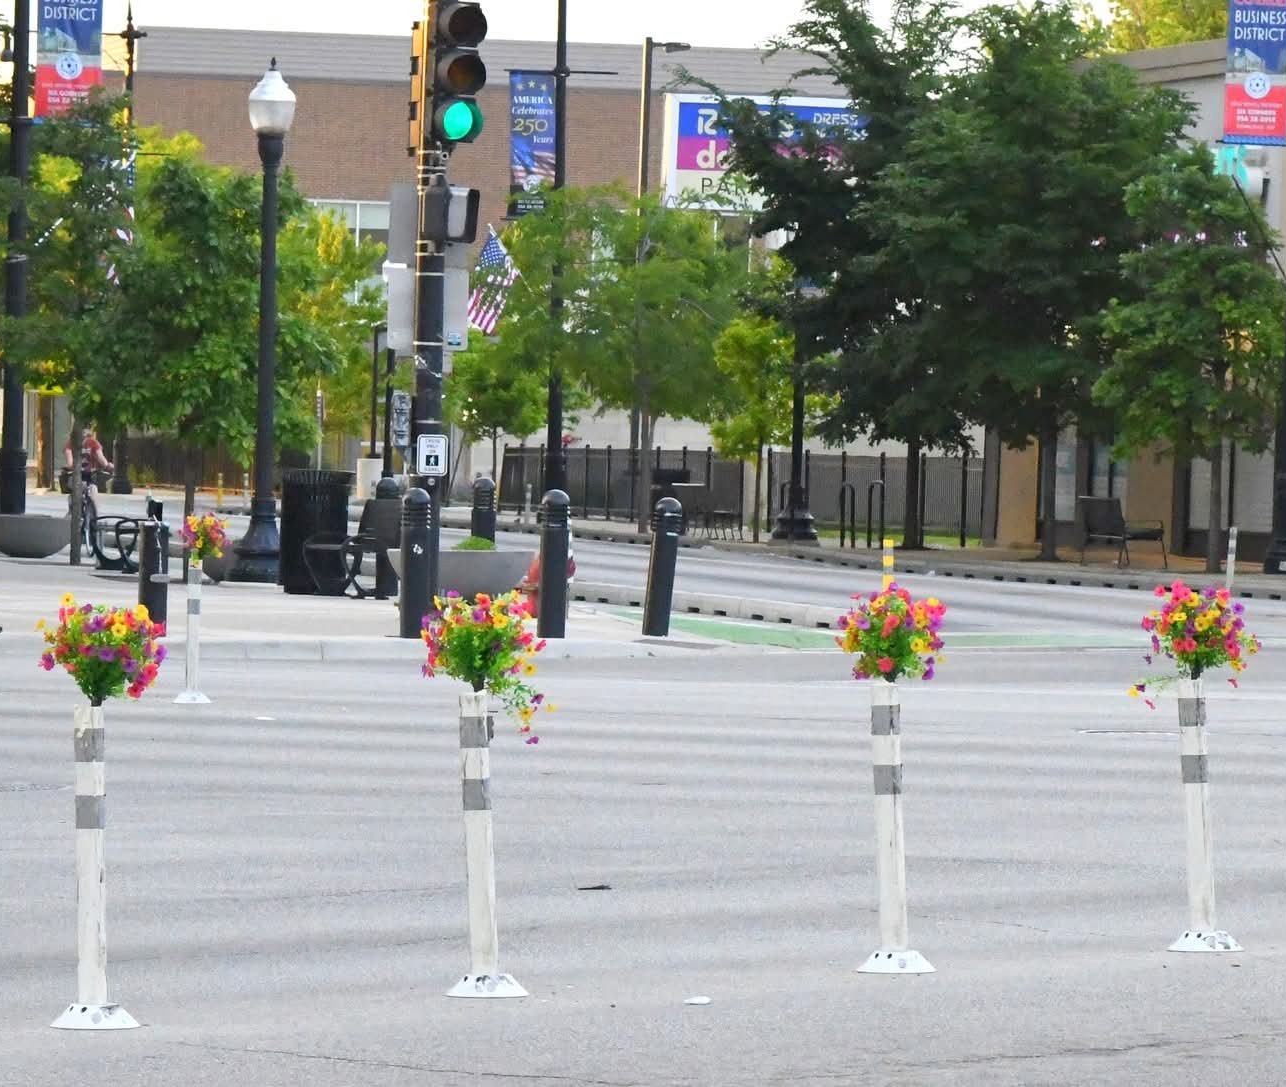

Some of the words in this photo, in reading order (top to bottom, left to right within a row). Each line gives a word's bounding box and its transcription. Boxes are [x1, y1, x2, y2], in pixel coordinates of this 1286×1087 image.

[44, 6, 98, 21] DISTRICT
[1234, 10, 1286, 25] BUSINESS
[1234, 27, 1286, 42] DISTRICT
[513, 96, 553, 105] AMERICA
[512, 106, 553, 116] Celebrates
[513, 118, 548, 136] 250
[533, 135, 554, 144] Years
